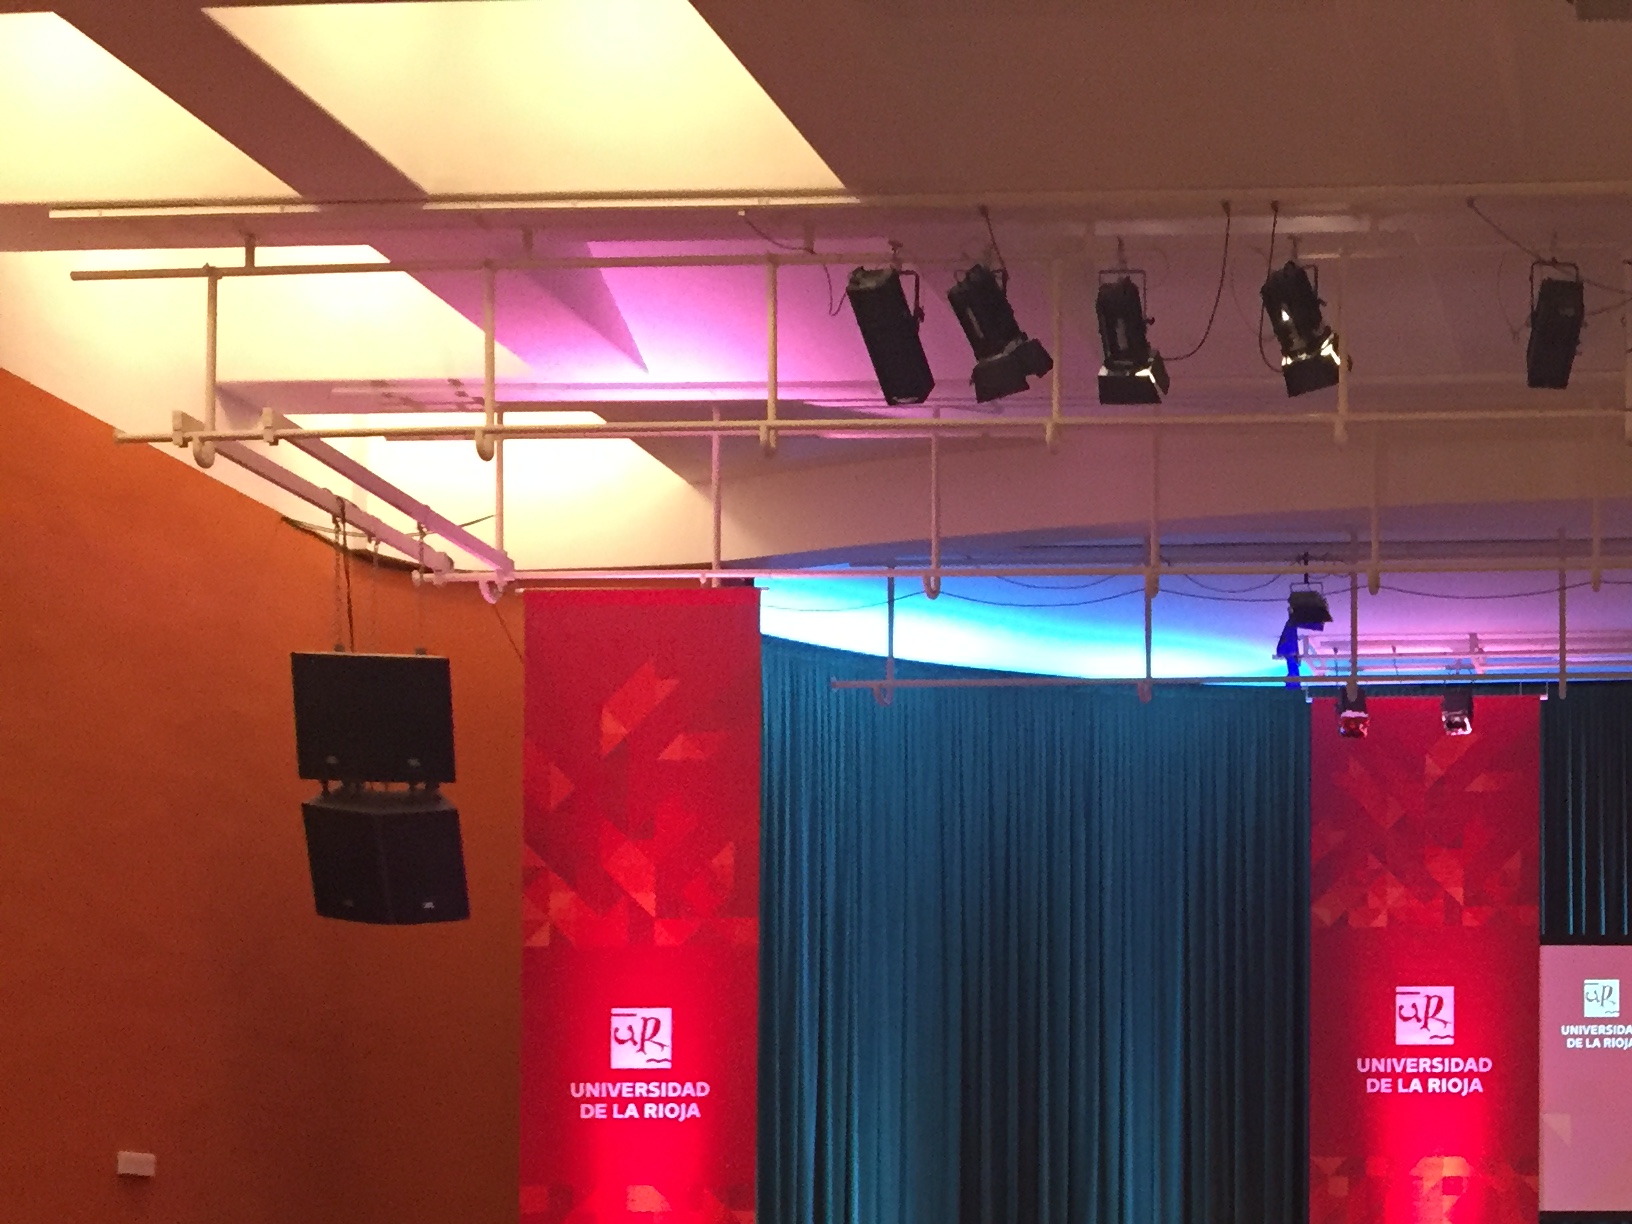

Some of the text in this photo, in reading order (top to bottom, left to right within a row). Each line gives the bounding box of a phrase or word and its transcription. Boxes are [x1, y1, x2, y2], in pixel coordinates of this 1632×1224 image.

[1566, 1038, 1583, 1049] DE
[1585, 1038, 1600, 1049] LA
[1356, 1057, 1493, 1073] UNIVERSIDAD
[570, 1082, 711, 1098] UNIVERSIDAD
[1366, 1077, 1483, 1097] DE LA RIOJA
[580, 1103, 701, 1122] DE LA RIOJA
